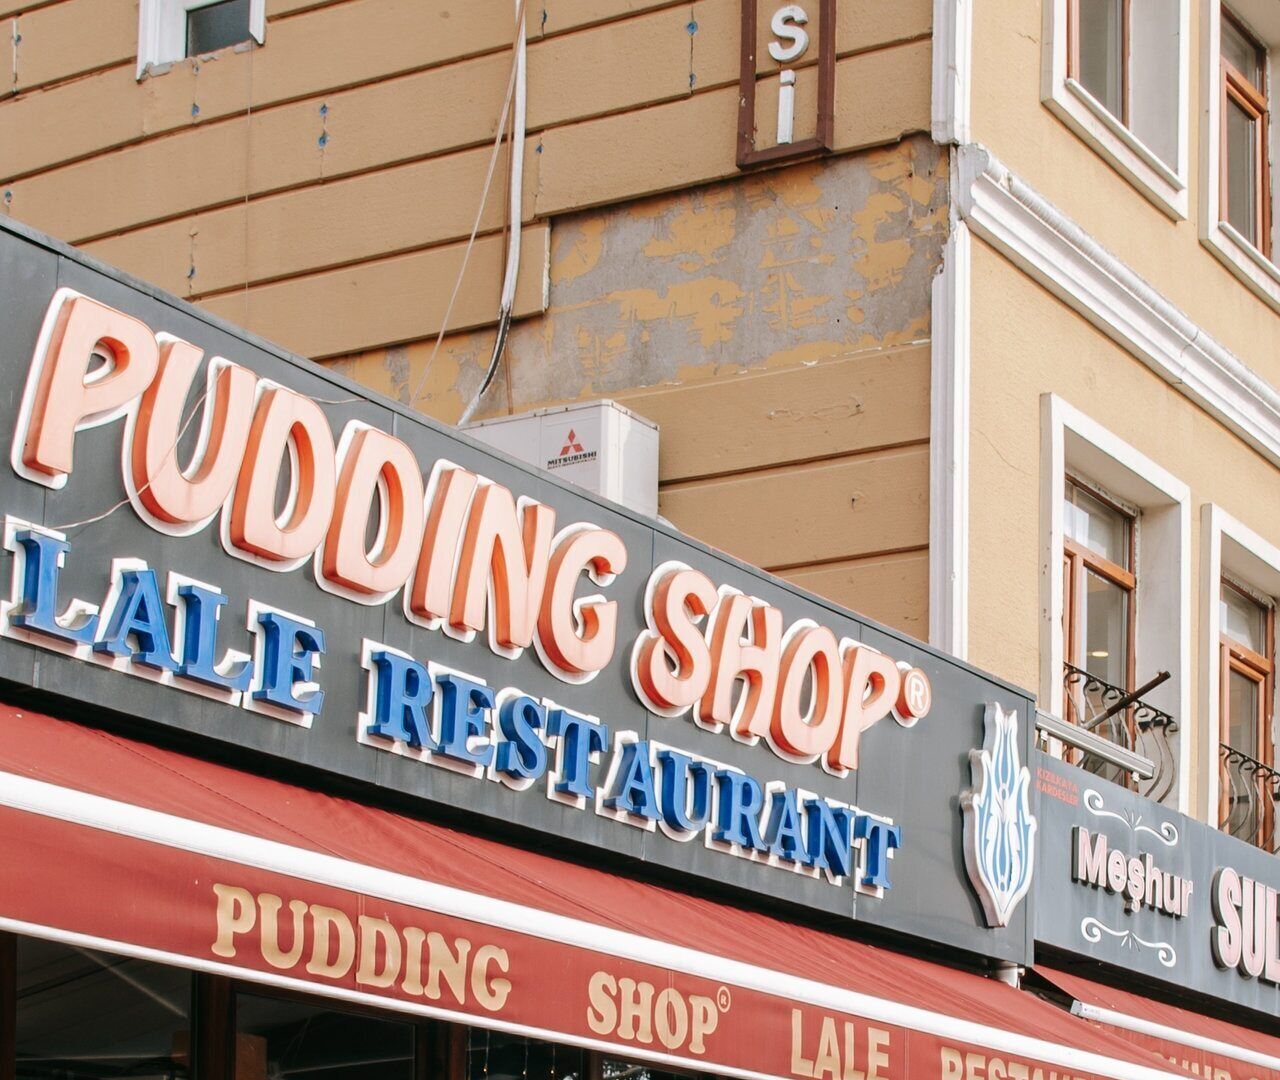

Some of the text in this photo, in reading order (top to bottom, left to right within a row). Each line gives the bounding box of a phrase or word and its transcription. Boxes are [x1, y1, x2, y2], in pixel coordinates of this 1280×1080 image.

[12, 287, 626, 684] PUDDING
[547, 451, 597, 467] MITSUBISHI
[357, 638, 902, 898] RESTAURANT
[1072, 824, 1194, 920] Meşhur
[210, 882, 513, 1012] PUDDING
